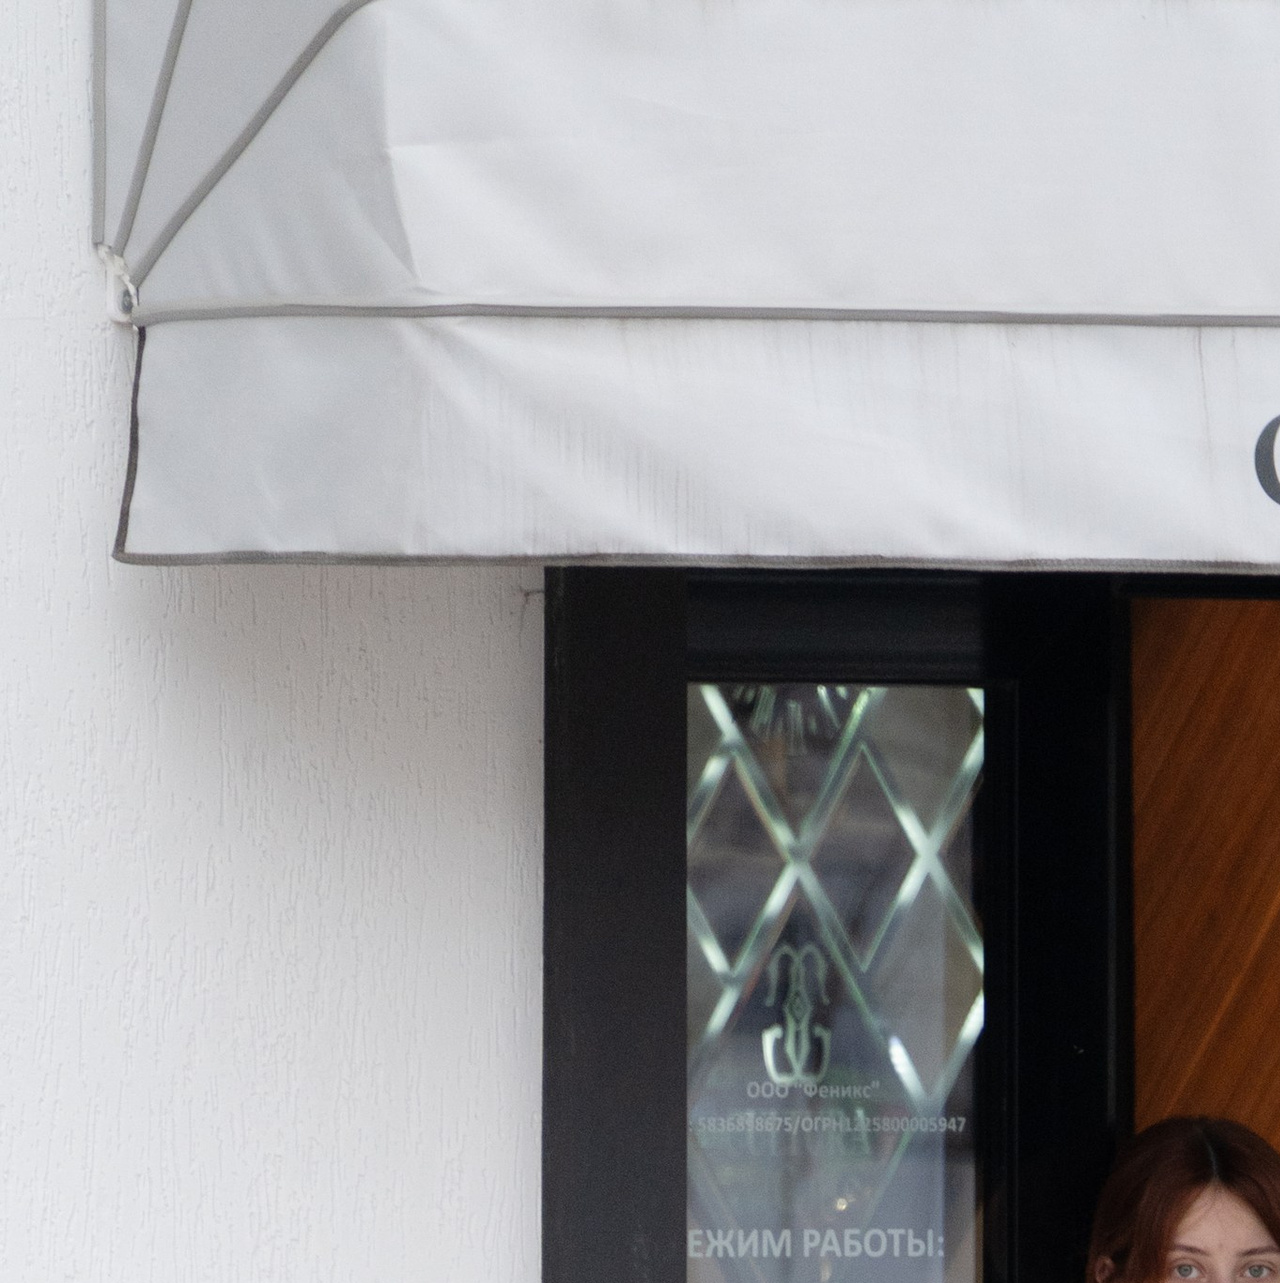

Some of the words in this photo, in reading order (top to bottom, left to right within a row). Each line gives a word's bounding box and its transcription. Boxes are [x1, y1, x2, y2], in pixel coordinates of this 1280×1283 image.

[747, 1081, 788, 1099] ООО
[794, 1079, 880, 1099] "Феникс"
[688, 1228, 791, 1258] ЕЖИМ
[803, 1228, 944, 1258] РАБОТЫ:
